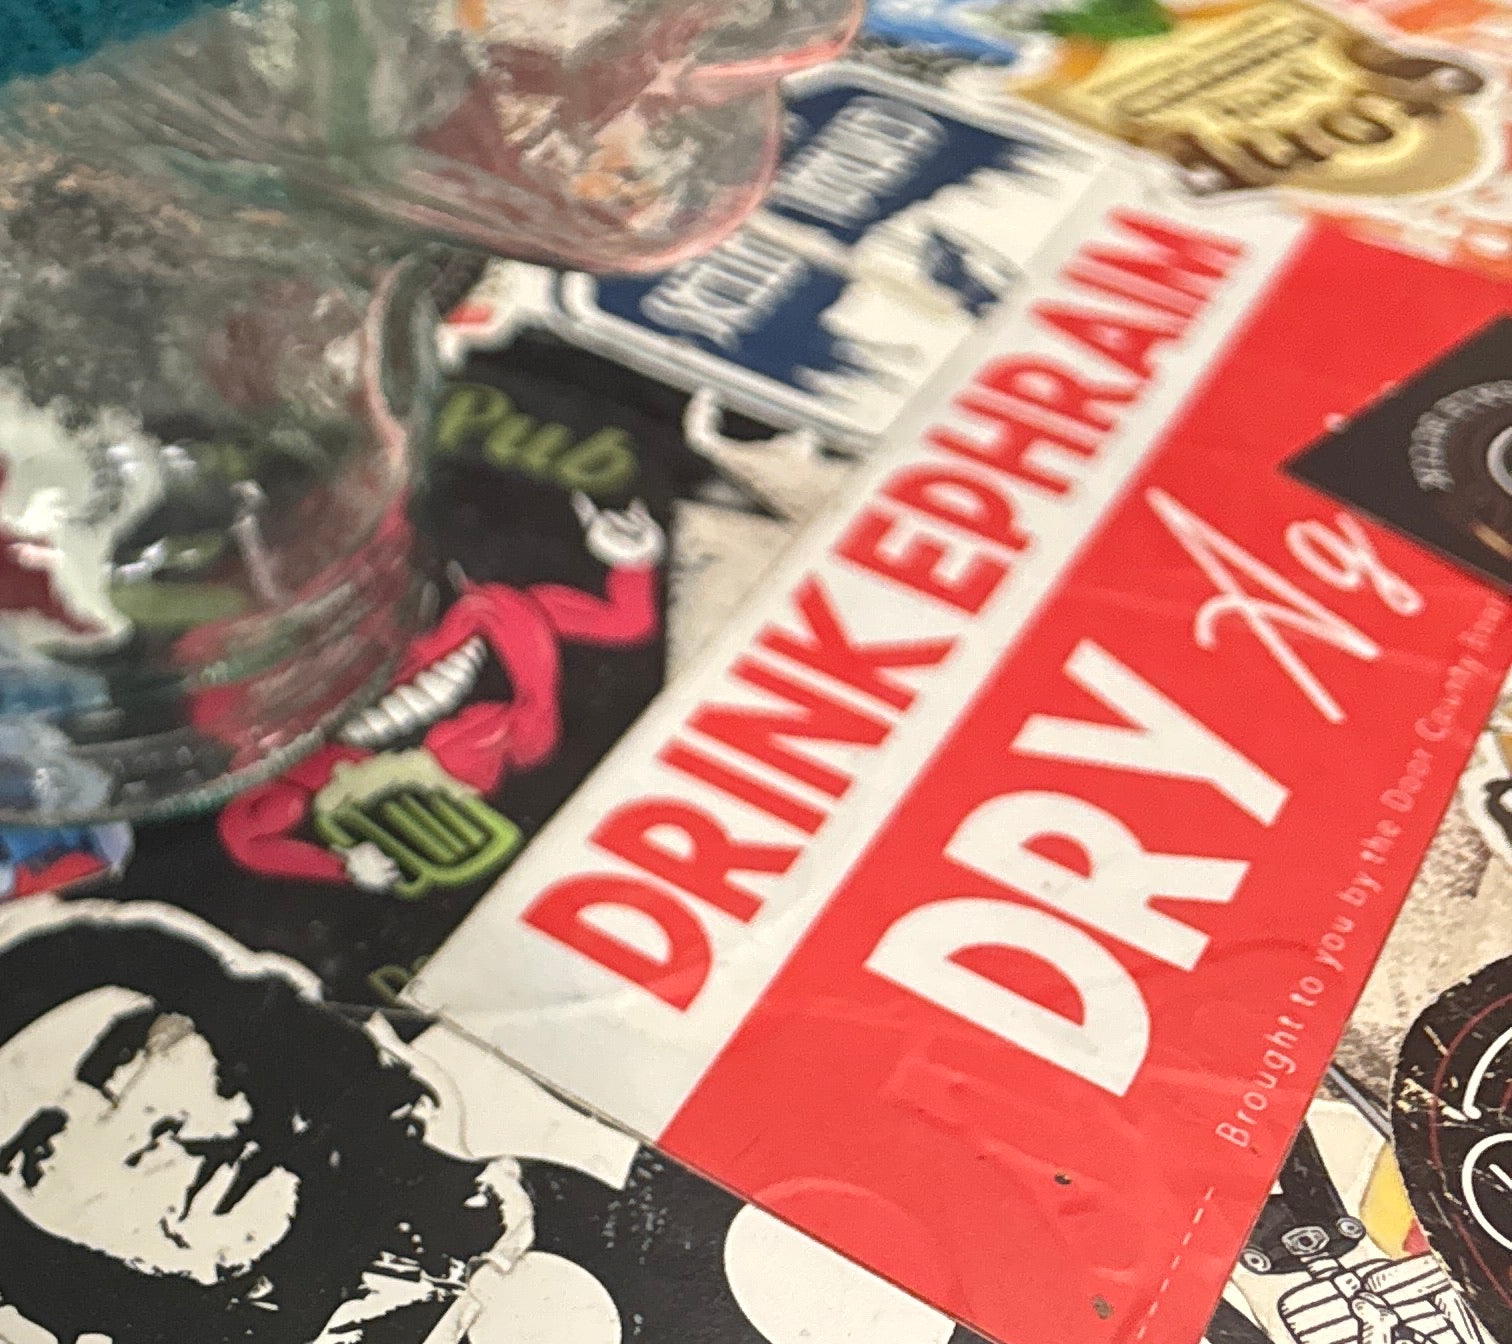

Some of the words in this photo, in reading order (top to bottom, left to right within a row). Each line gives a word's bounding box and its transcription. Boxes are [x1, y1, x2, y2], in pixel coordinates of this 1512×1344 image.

[437, 384, 639, 494] Pub
[518, 572, 962, 1014] DRINK
[831, 207, 1248, 617] EPHRAIM
[1380, 746, 1435, 813] Door
[863, 638, 1290, 1097] DRY
[1363, 819, 1402, 865] the
[1338, 869, 1384, 911] by
[1314, 914, 1357, 972] you
[1289, 975, 1325, 1007] to
[1215, 1013, 1306, 1149] Brought
